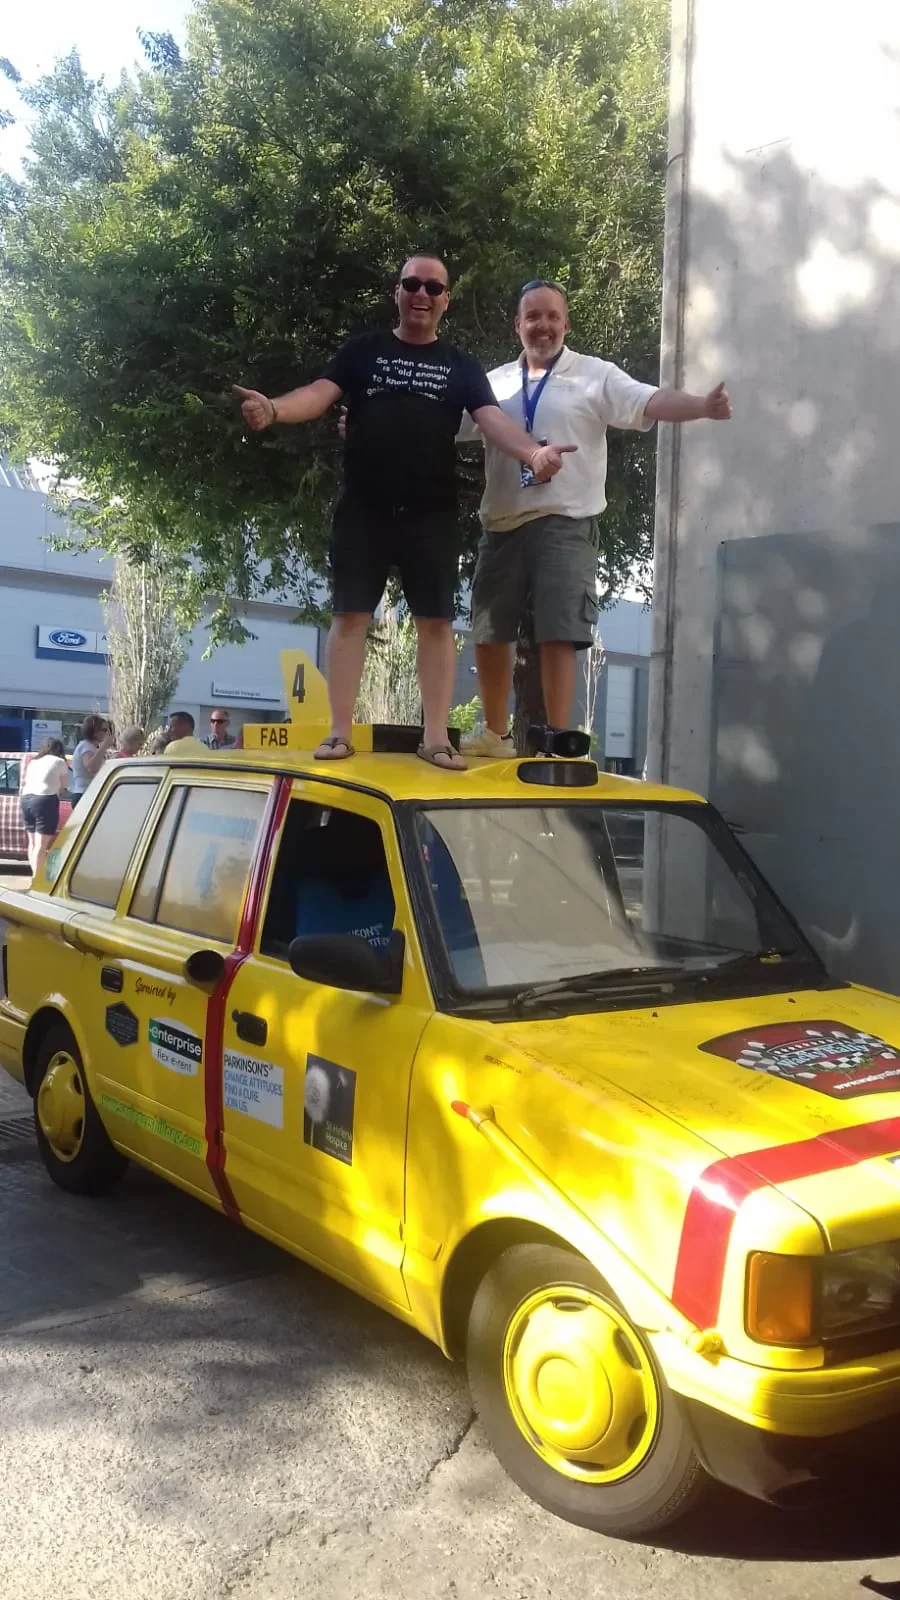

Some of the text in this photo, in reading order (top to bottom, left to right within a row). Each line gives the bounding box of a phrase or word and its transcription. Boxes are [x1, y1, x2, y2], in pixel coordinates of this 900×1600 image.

[376, 356, 451, 374] So when exactly
[372, 373, 382, 383] to
[386, 375, 408, 385] know
[416, 372, 447, 380] enough
[292, 663, 306, 703] 4
[260, 727, 288, 747] FAB
[168, 987, 177, 1006] by
[150, 1026, 202, 1056] enterprise
[223, 1053, 269, 1077] PARKINSON'S
[224, 1070, 248, 1087] CHANGE
[224, 1082, 238, 1096] FIND
[238, 1087, 243, 1097] A
